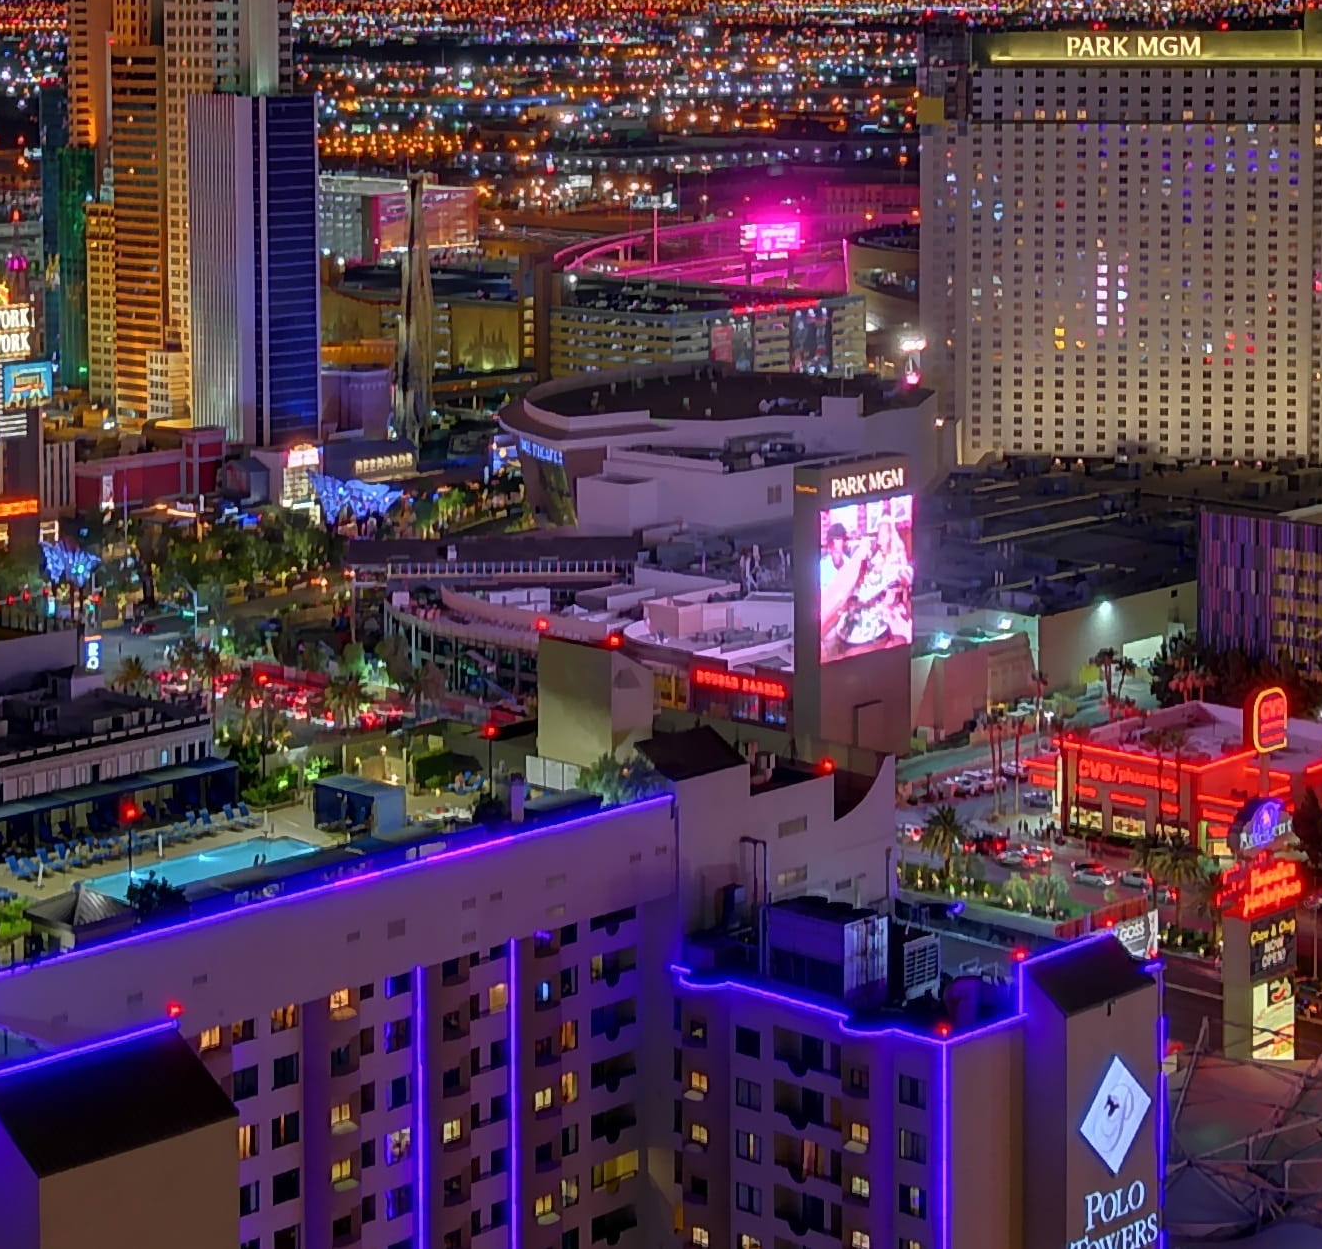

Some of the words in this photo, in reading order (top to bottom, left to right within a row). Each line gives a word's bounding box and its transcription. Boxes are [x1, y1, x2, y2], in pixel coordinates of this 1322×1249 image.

[1066, 35, 1129, 57] PARK
[1137, 35, 1201, 57] MGM
[831, 473, 868, 499] PARK
[868, 467, 904, 492] MGM
[1085, 1179, 1146, 1233] POLO
